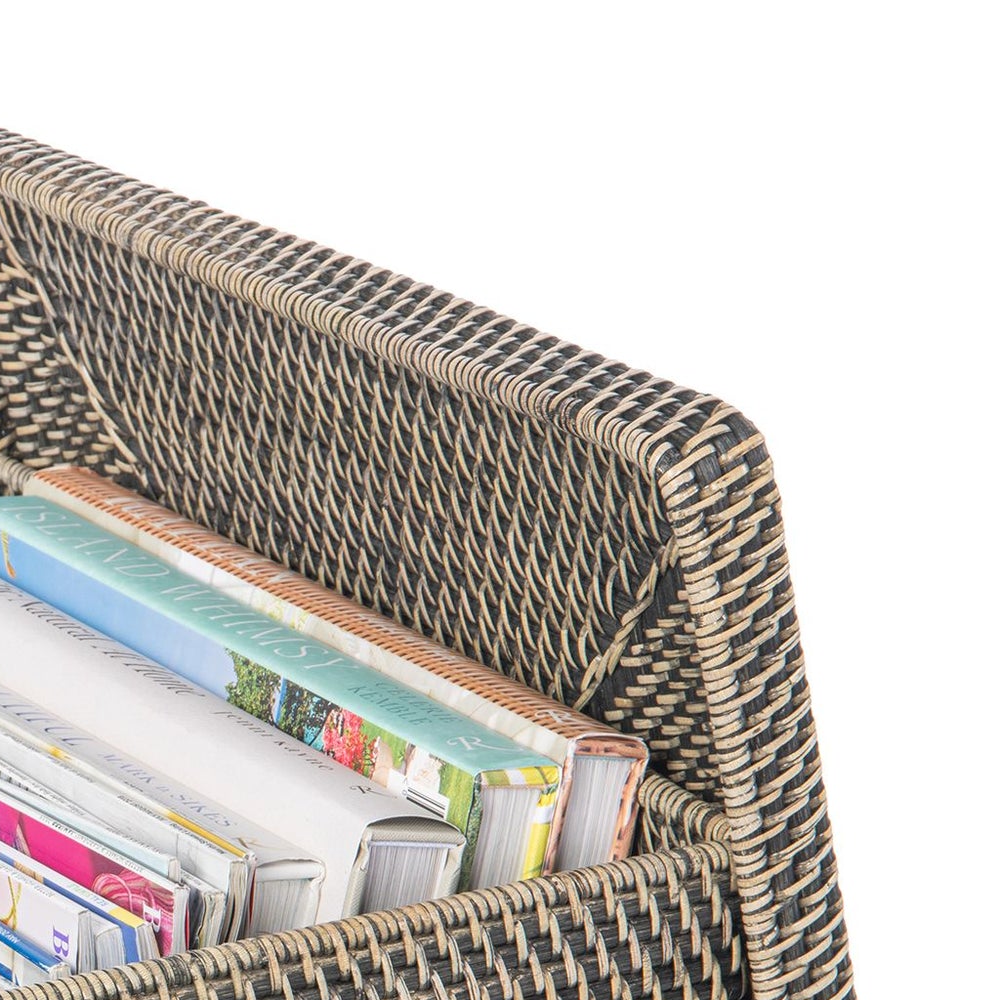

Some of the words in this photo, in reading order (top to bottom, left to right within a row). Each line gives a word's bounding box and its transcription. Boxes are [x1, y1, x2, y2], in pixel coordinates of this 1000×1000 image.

[1, 504, 170, 578] ISLAND
[159, 583, 359, 670] WHIMSY
[346, 685, 432, 726] KEMBLE
